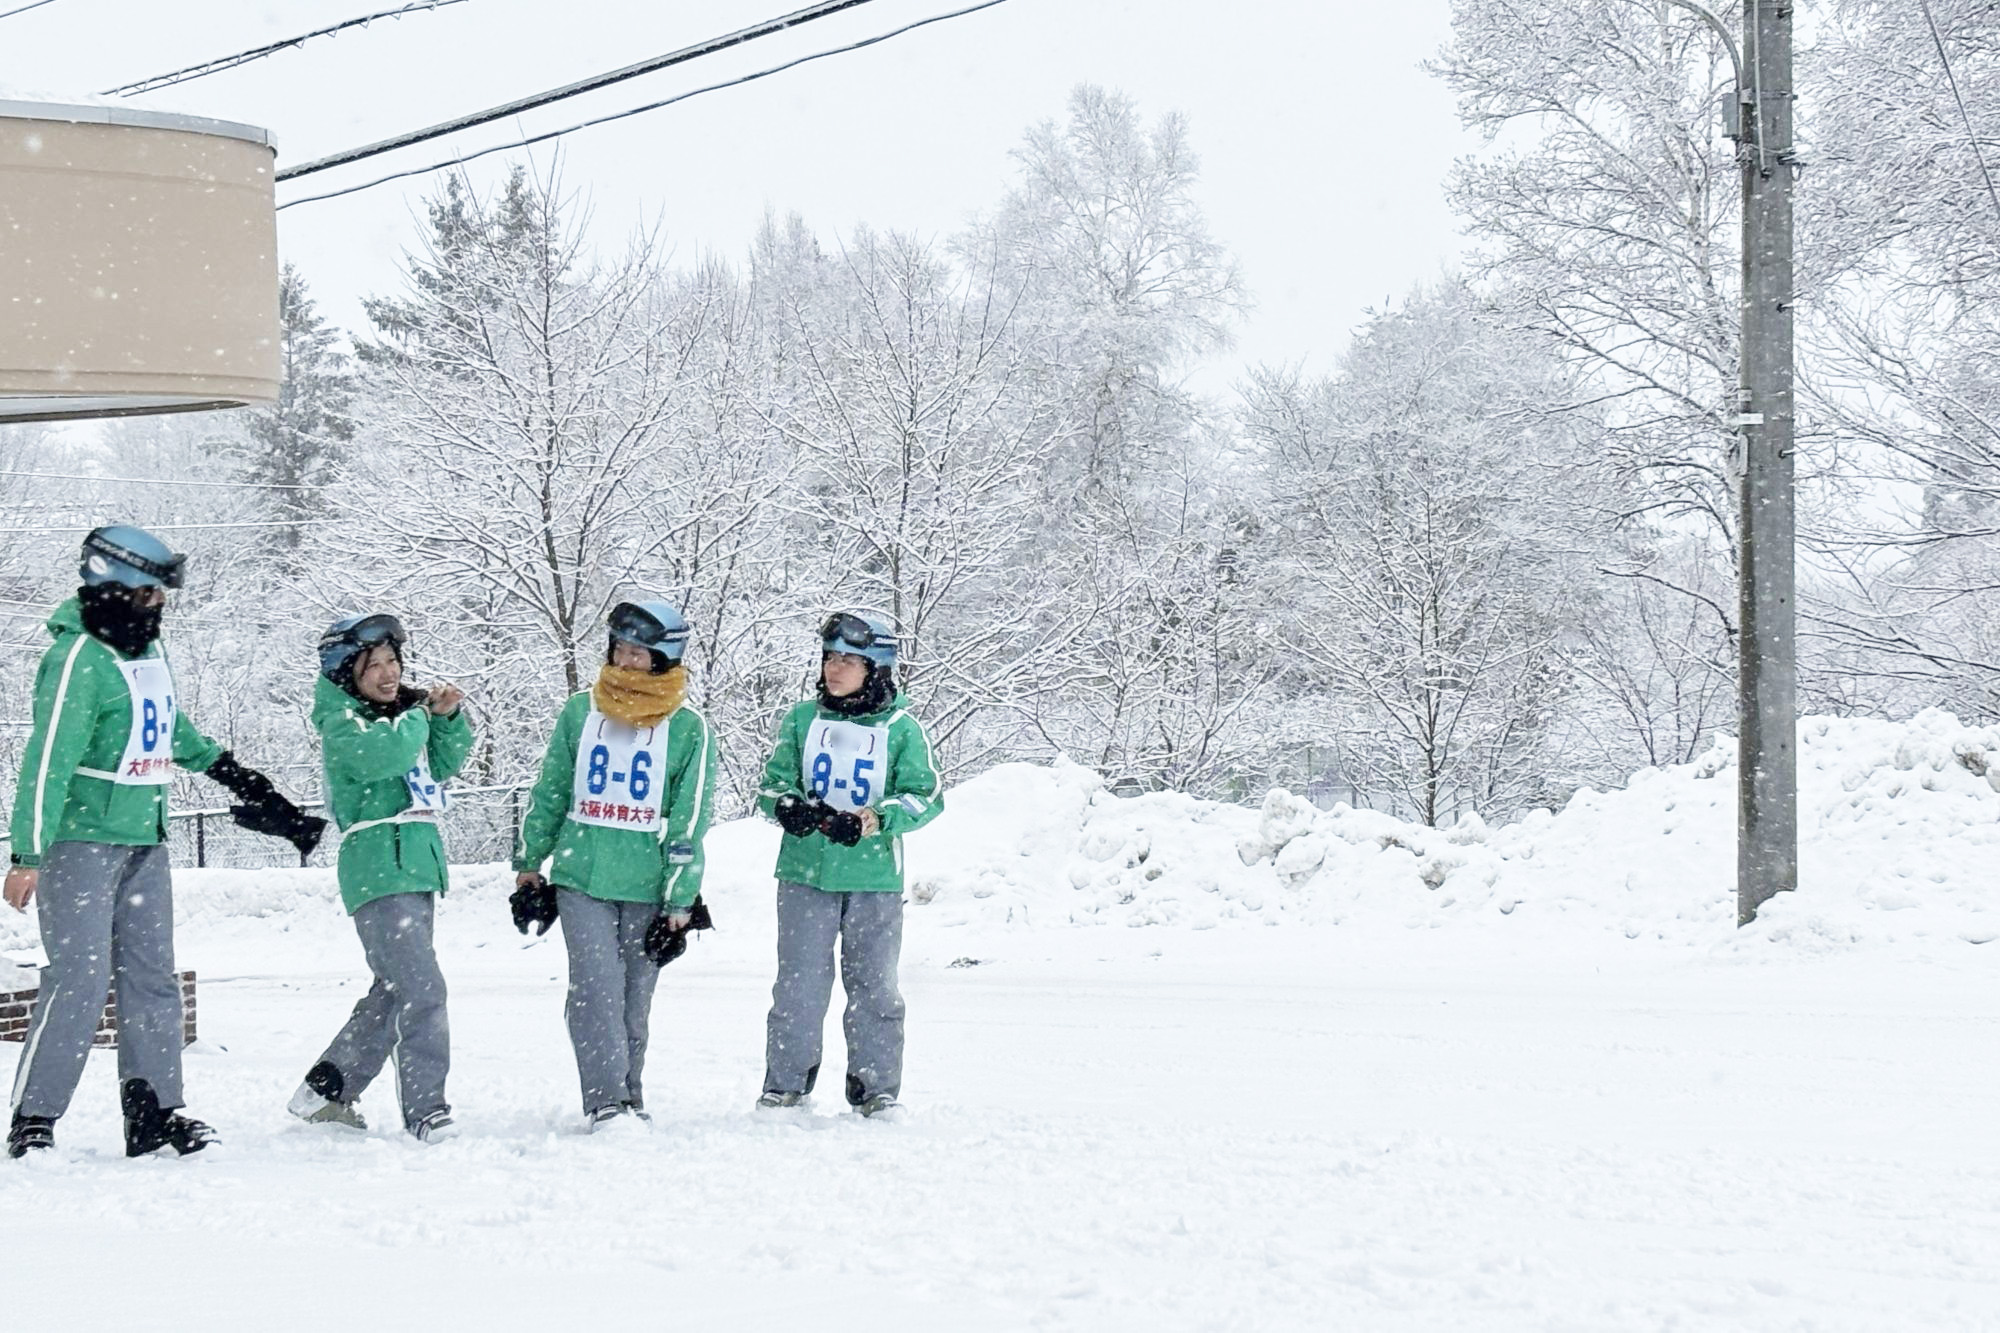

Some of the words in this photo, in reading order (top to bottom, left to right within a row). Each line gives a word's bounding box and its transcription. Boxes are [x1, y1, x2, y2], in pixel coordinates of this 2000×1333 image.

[142, 695, 172, 752] 8-
[587, 744, 652, 801] 8-6
[812, 752, 874, 807] 8-5
[579, 800, 656, 825] 大阪体育大学
